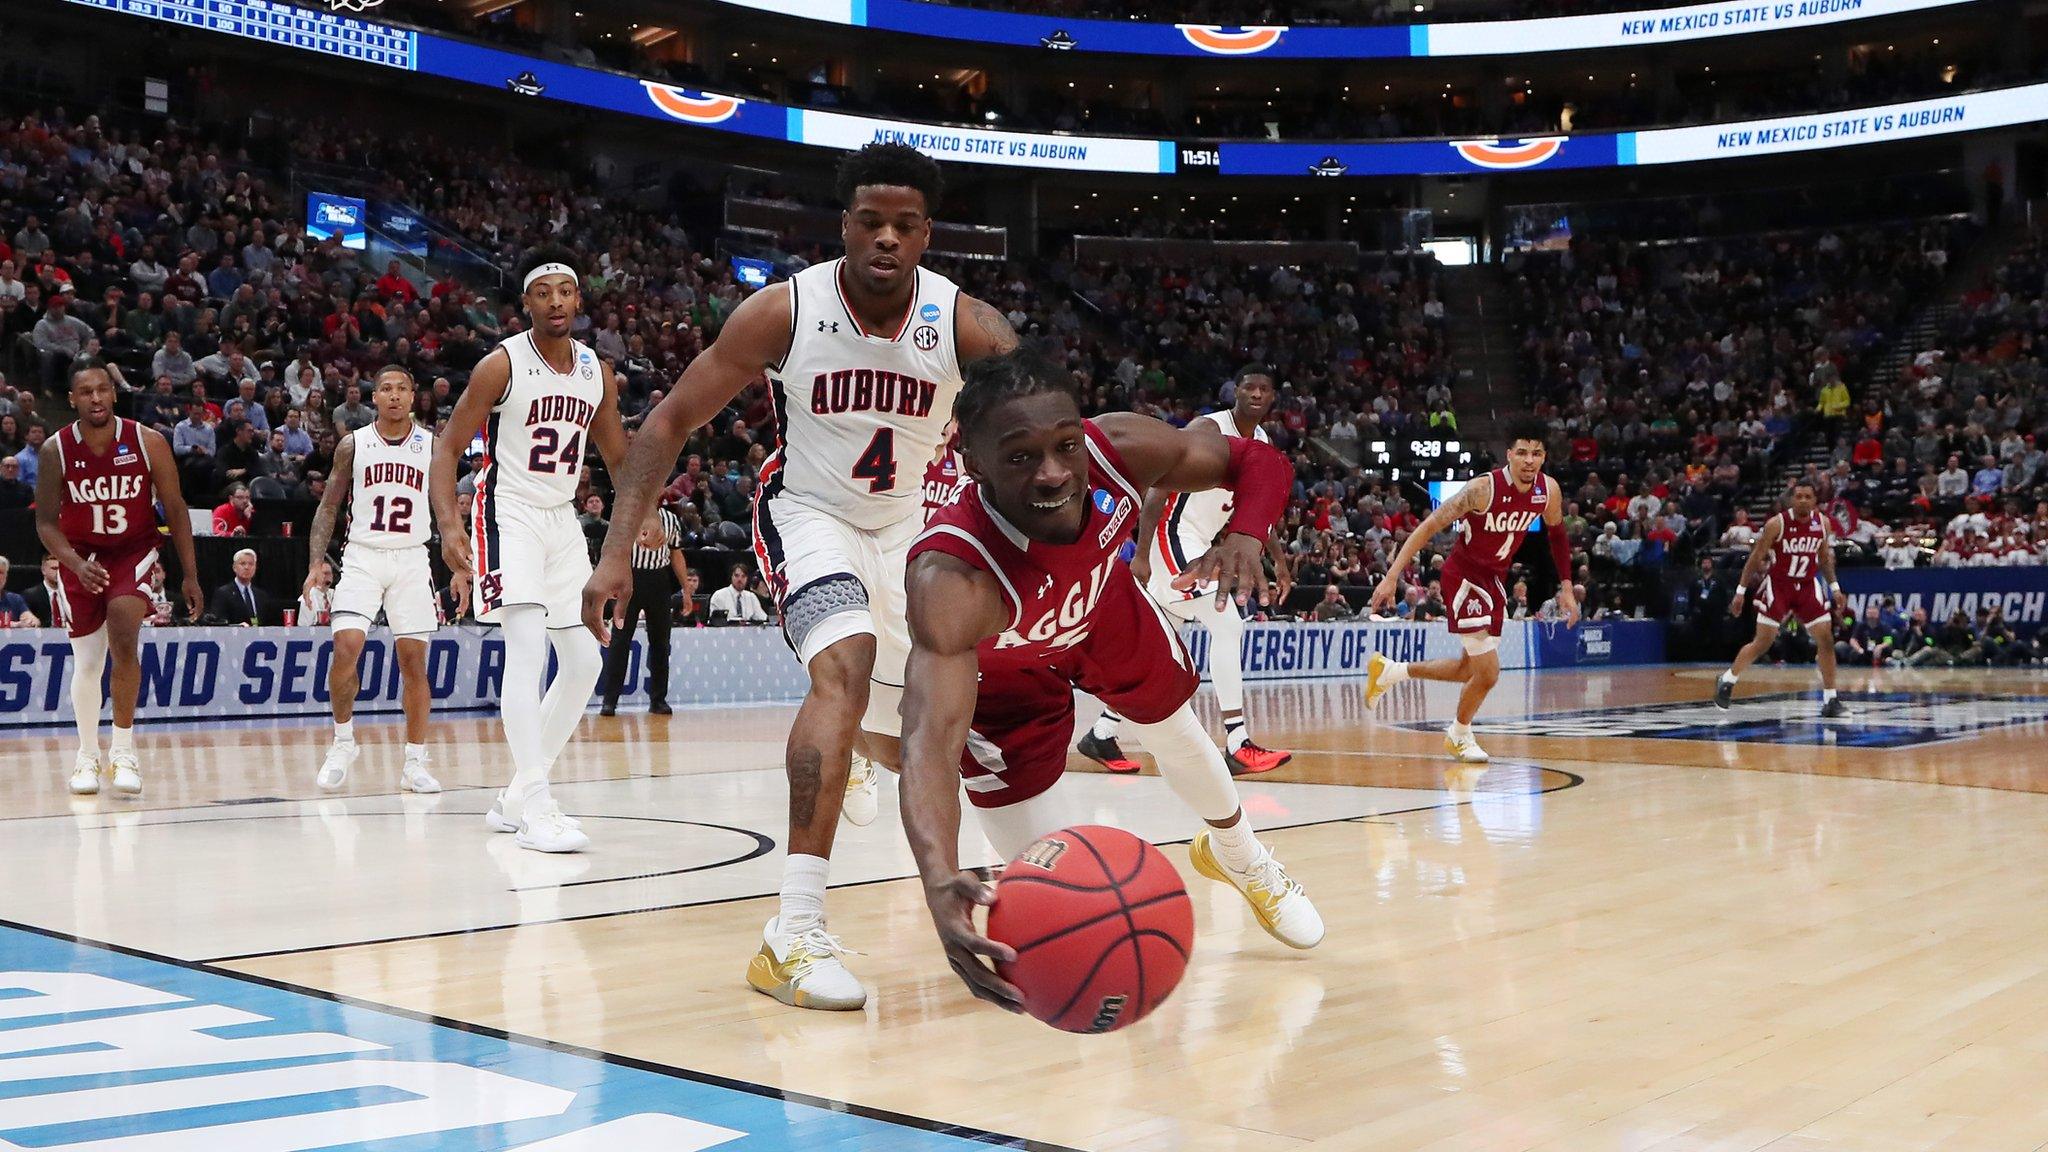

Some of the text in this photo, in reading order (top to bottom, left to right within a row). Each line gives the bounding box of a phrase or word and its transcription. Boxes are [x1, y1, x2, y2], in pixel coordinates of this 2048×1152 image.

[216, 19, 235, 30] 100
[1622, 0, 1862, 36] NEW MEXICO STATE VS AUBURN
[874, 128, 1088, 161] NEW MEXICO STATE VS AUBURN
[1717, 105, 1966, 149] NEW MEXICO STATE VS AUBURN
[915, 327, 937, 349] SEC
[811, 368, 938, 418] AUBURN
[525, 395, 595, 431] AUBURN
[528, 427, 581, 475] 24
[851, 426, 898, 494] 4
[1410, 440, 1441, 457] 9:28
[67, 475, 144, 504] AGGIES
[364, 462, 425, 493] AUBURN
[91, 503, 129, 535] 13
[369, 495, 414, 534] 12
[1787, 554, 1810, 578] 12
[1190, 628, 1427, 674] UVERSITY OF UTAH
[101, 641, 220, 709] ND
